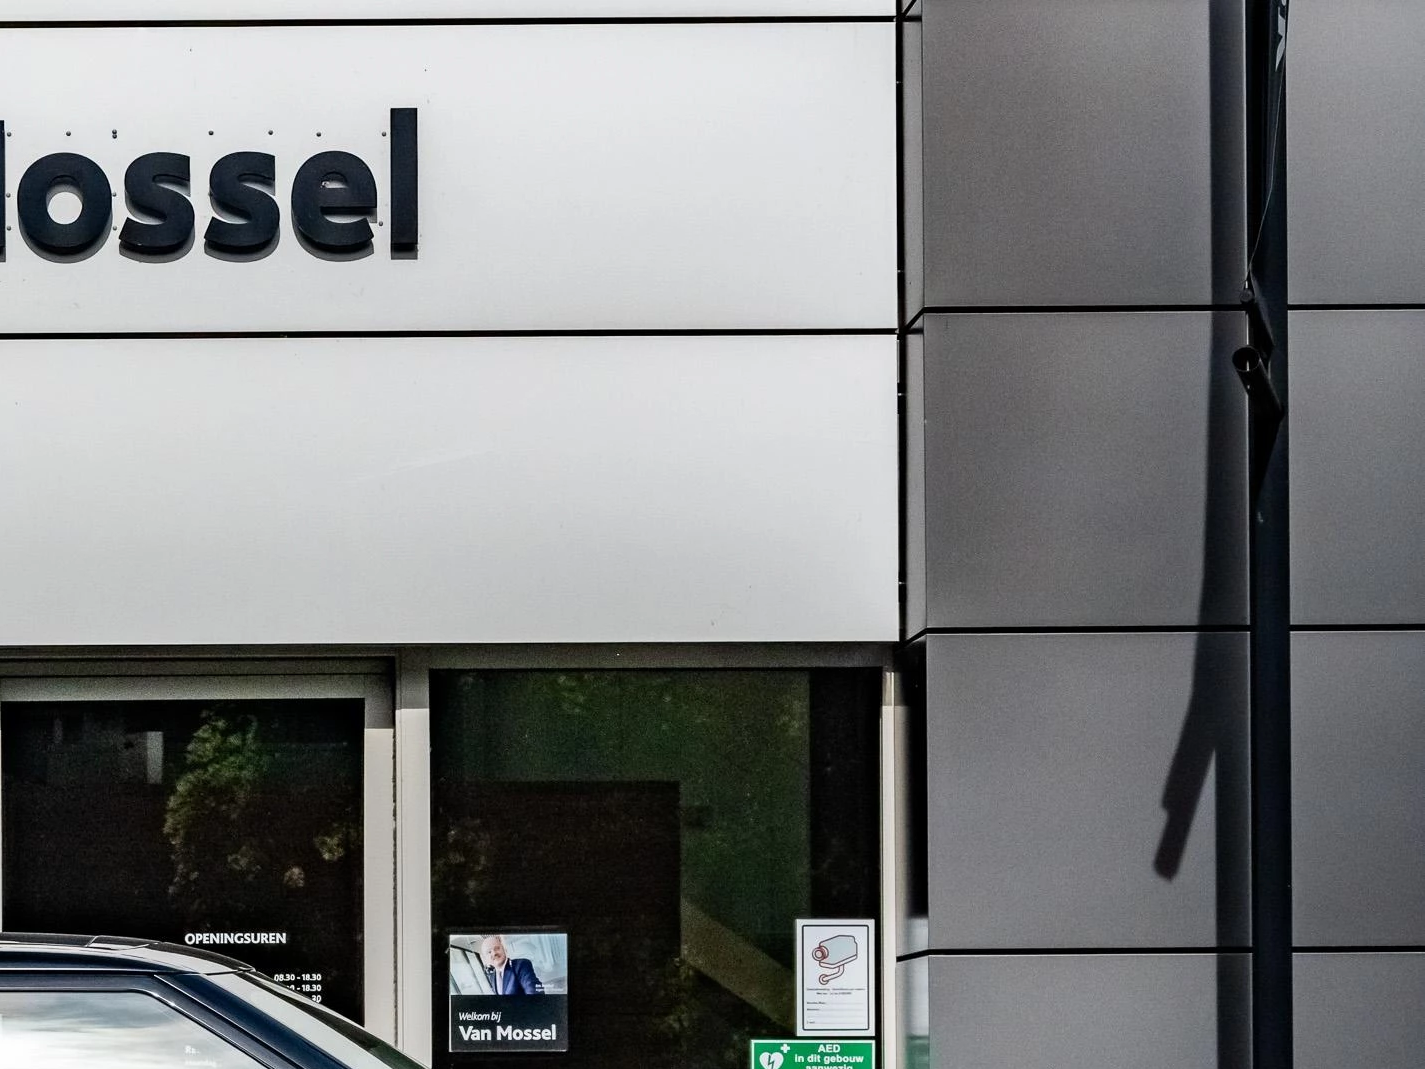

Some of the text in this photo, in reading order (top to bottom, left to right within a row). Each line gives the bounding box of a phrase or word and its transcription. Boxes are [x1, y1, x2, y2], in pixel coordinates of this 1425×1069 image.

[185, 932, 287, 944] OPENINGSUREN
[301, 973, 322, 981] 18.30
[301, 984, 322, 992] 18.30
[459, 1012, 502, 1023] Welkom bij
[459, 1024, 557, 1041] Van Mossel
[818, 1044, 841, 1053] AED
[807, 1054, 821, 1063] dit
[824, 1054, 864, 1065] gebouw
